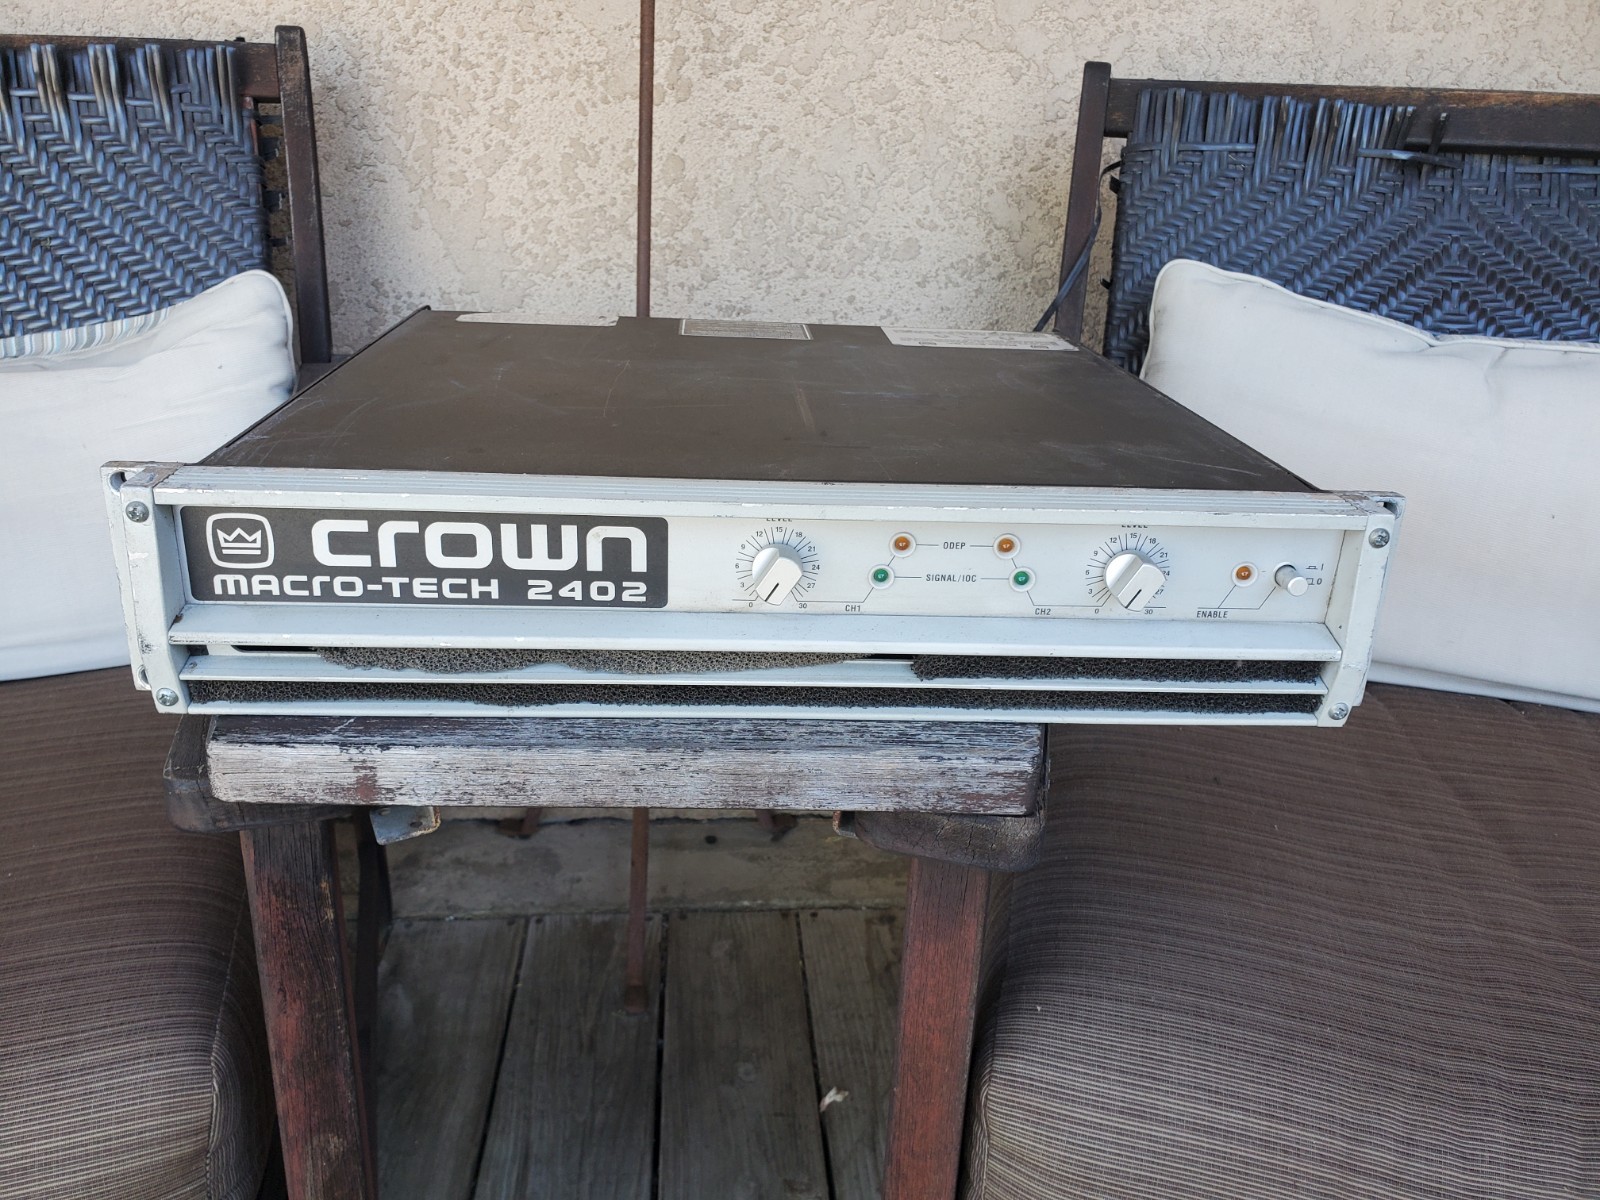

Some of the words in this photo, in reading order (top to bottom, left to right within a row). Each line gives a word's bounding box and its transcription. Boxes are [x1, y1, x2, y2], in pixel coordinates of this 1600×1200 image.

[943, 542, 966, 550] ODEP
[926, 573, 977, 583] SIGNAL/IOC
[526, 579, 648, 602] 2402
[845, 604, 861, 612] CH1
[1034, 607, 1052, 615] CH2
[1196, 610, 1228, 618] ENABLE
